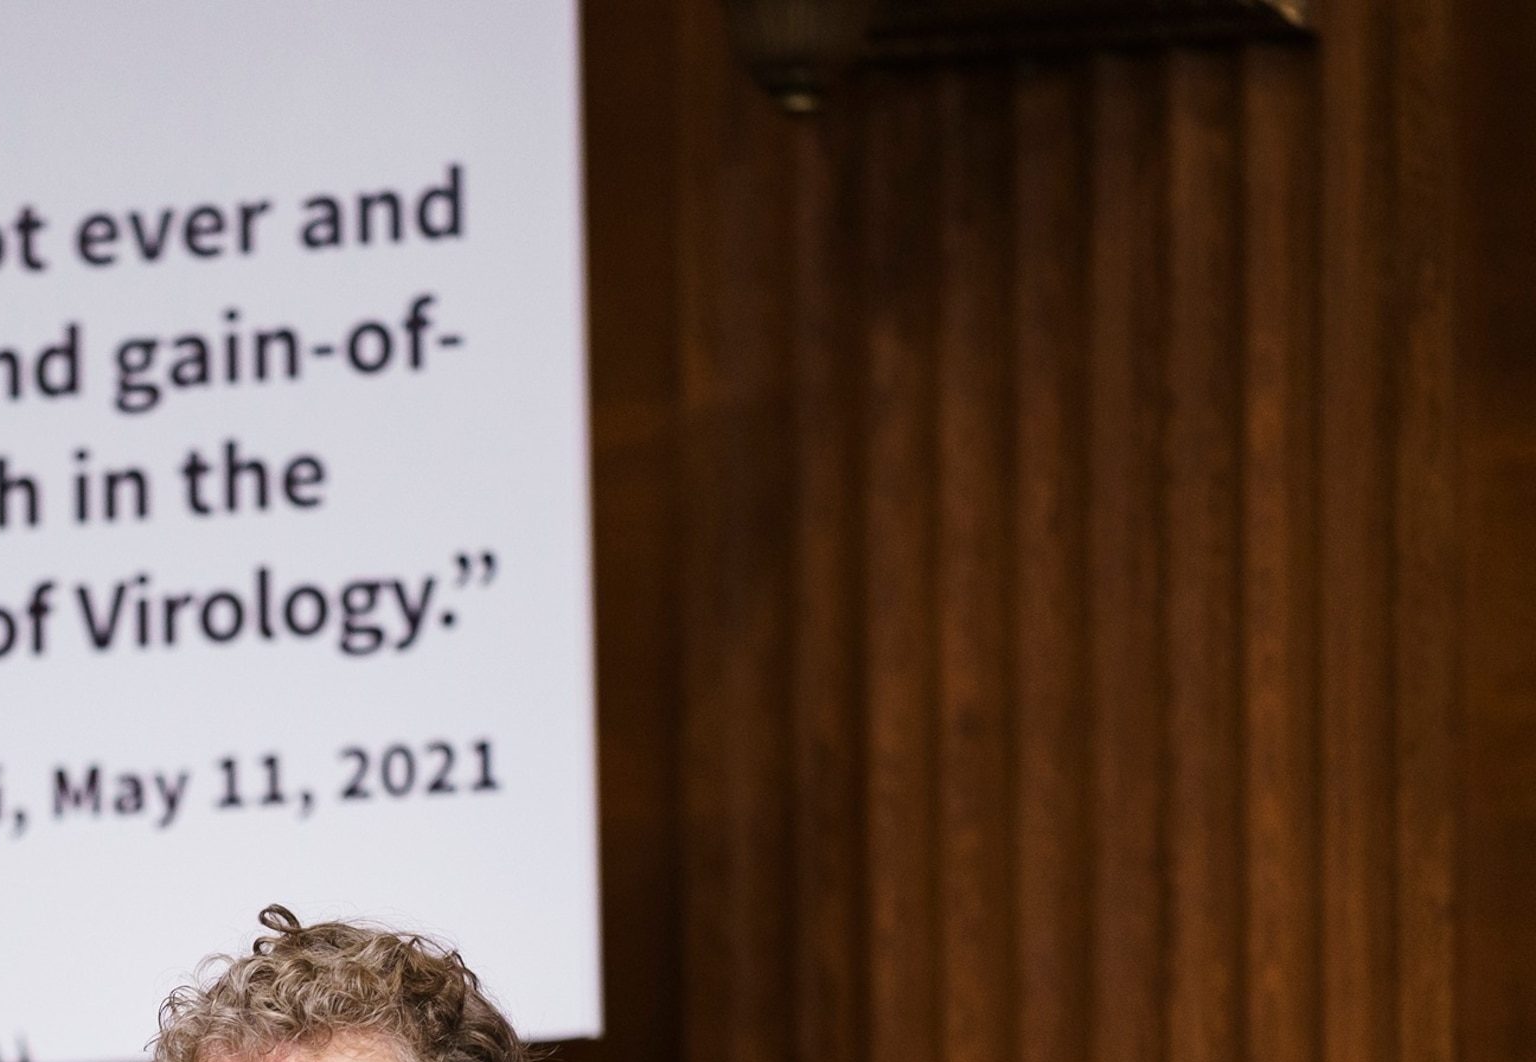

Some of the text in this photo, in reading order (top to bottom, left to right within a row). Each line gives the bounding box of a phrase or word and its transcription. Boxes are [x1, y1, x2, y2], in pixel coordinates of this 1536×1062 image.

[75, 195, 271, 270] ever
[300, 163, 465, 252] and
[114, 293, 462, 416] gain-of-
[74, 449, 149, 525] in
[180, 439, 326, 518] the
[53, 759, 188, 824] May
[216, 756, 316, 814] 11,
[340, 739, 502, 803] 2021
